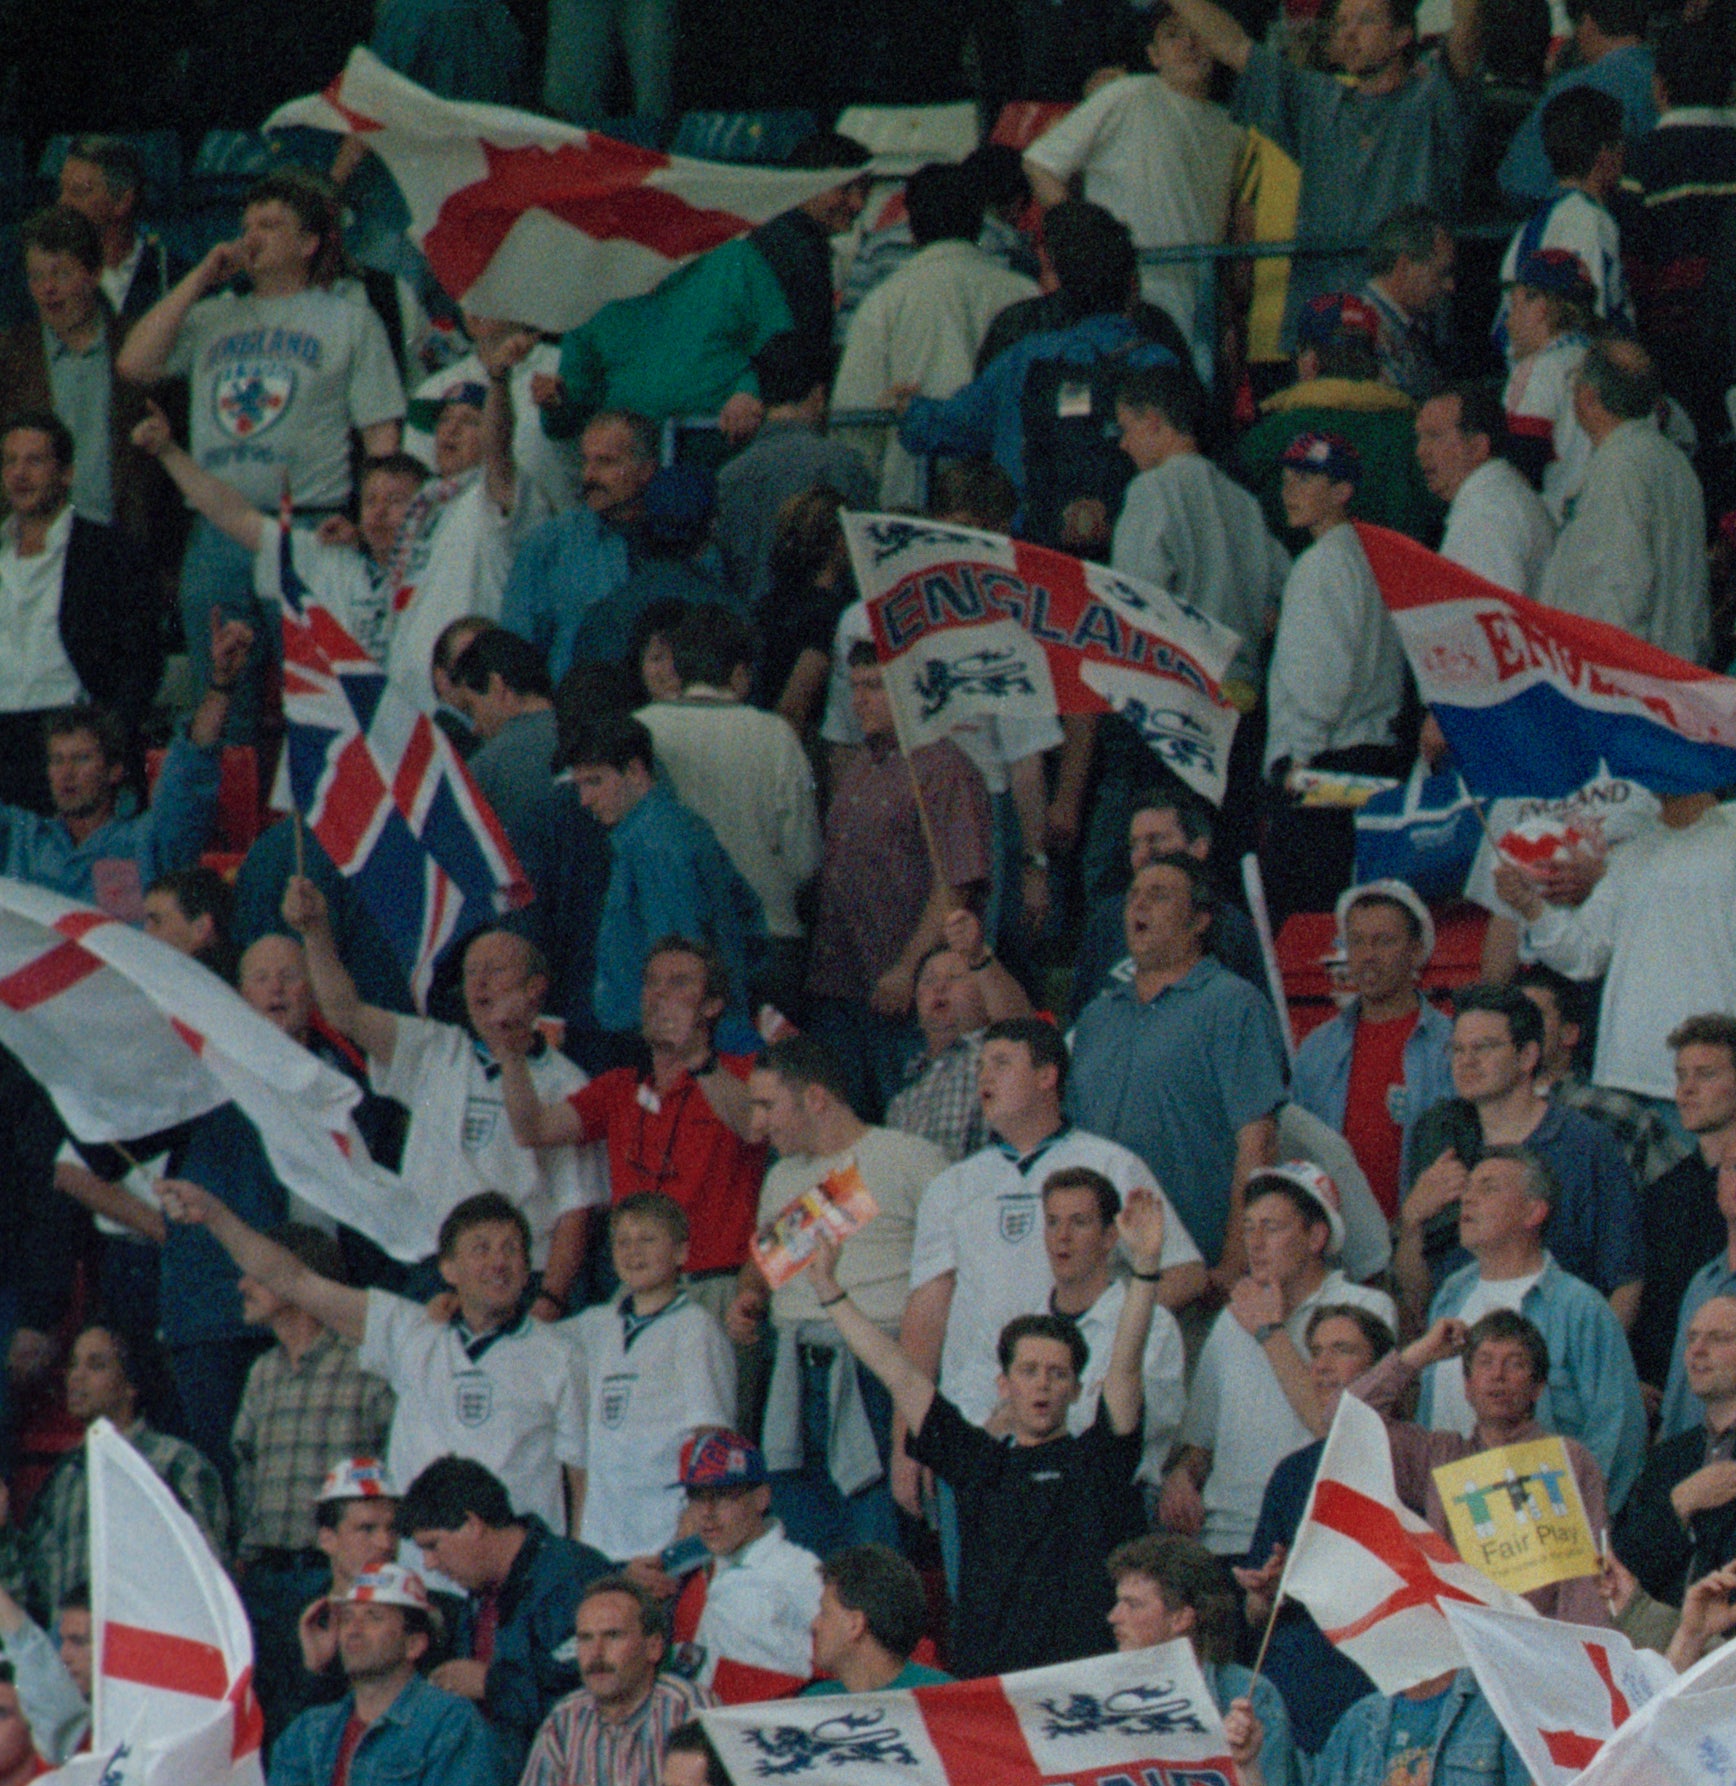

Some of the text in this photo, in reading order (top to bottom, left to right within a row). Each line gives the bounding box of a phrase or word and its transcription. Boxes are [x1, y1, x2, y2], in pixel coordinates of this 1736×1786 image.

[874, 558, 1228, 703] ENGLA
[1480, 1535, 1529, 1565] Fair
[1536, 1522, 1578, 1550] Play
